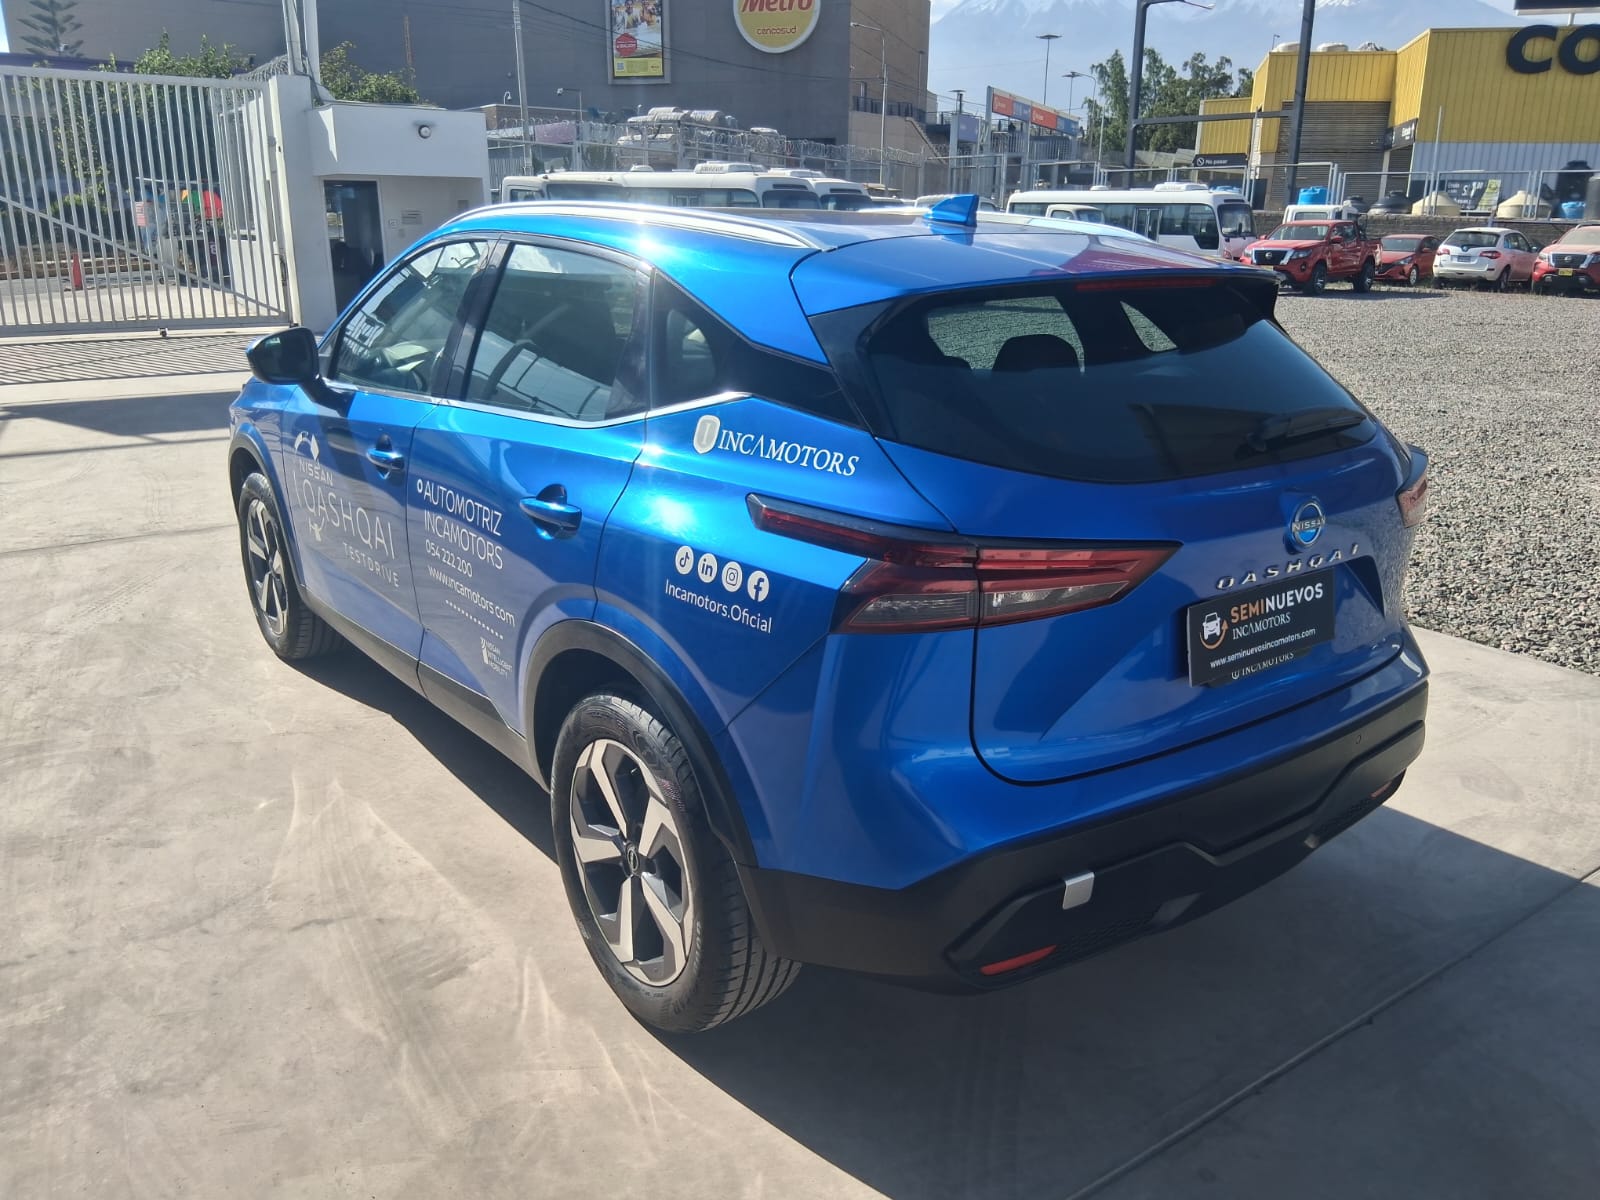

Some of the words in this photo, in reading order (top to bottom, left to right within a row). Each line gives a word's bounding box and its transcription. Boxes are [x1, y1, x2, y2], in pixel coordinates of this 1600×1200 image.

[756, 26, 797, 35] cencosud
[1506, 24, 1600, 75] CO
[299, 460, 333, 486] NISSAN
[718, 429, 860, 476] INCAMOTORS
[302, 478, 396, 560] QASHQAI
[423, 480, 503, 537] AUTOMOTRIZ
[1292, 515, 1326, 533] NISSAN
[424, 509, 504, 570] INCAMOTORS
[425, 539, 441, 560] 054
[441, 548, 457, 569] 222
[457, 556, 473, 578] 200
[427, 565, 516, 628] www.incamotors.com
[665, 579, 773, 634] Incamotors.Oficial
[1230, 582, 1324, 624] SEMINUEVOS
[1232, 611, 1291, 640] INCAMOTORS
[1210, 628, 1316, 669] www.seminuevosincamotors.com
